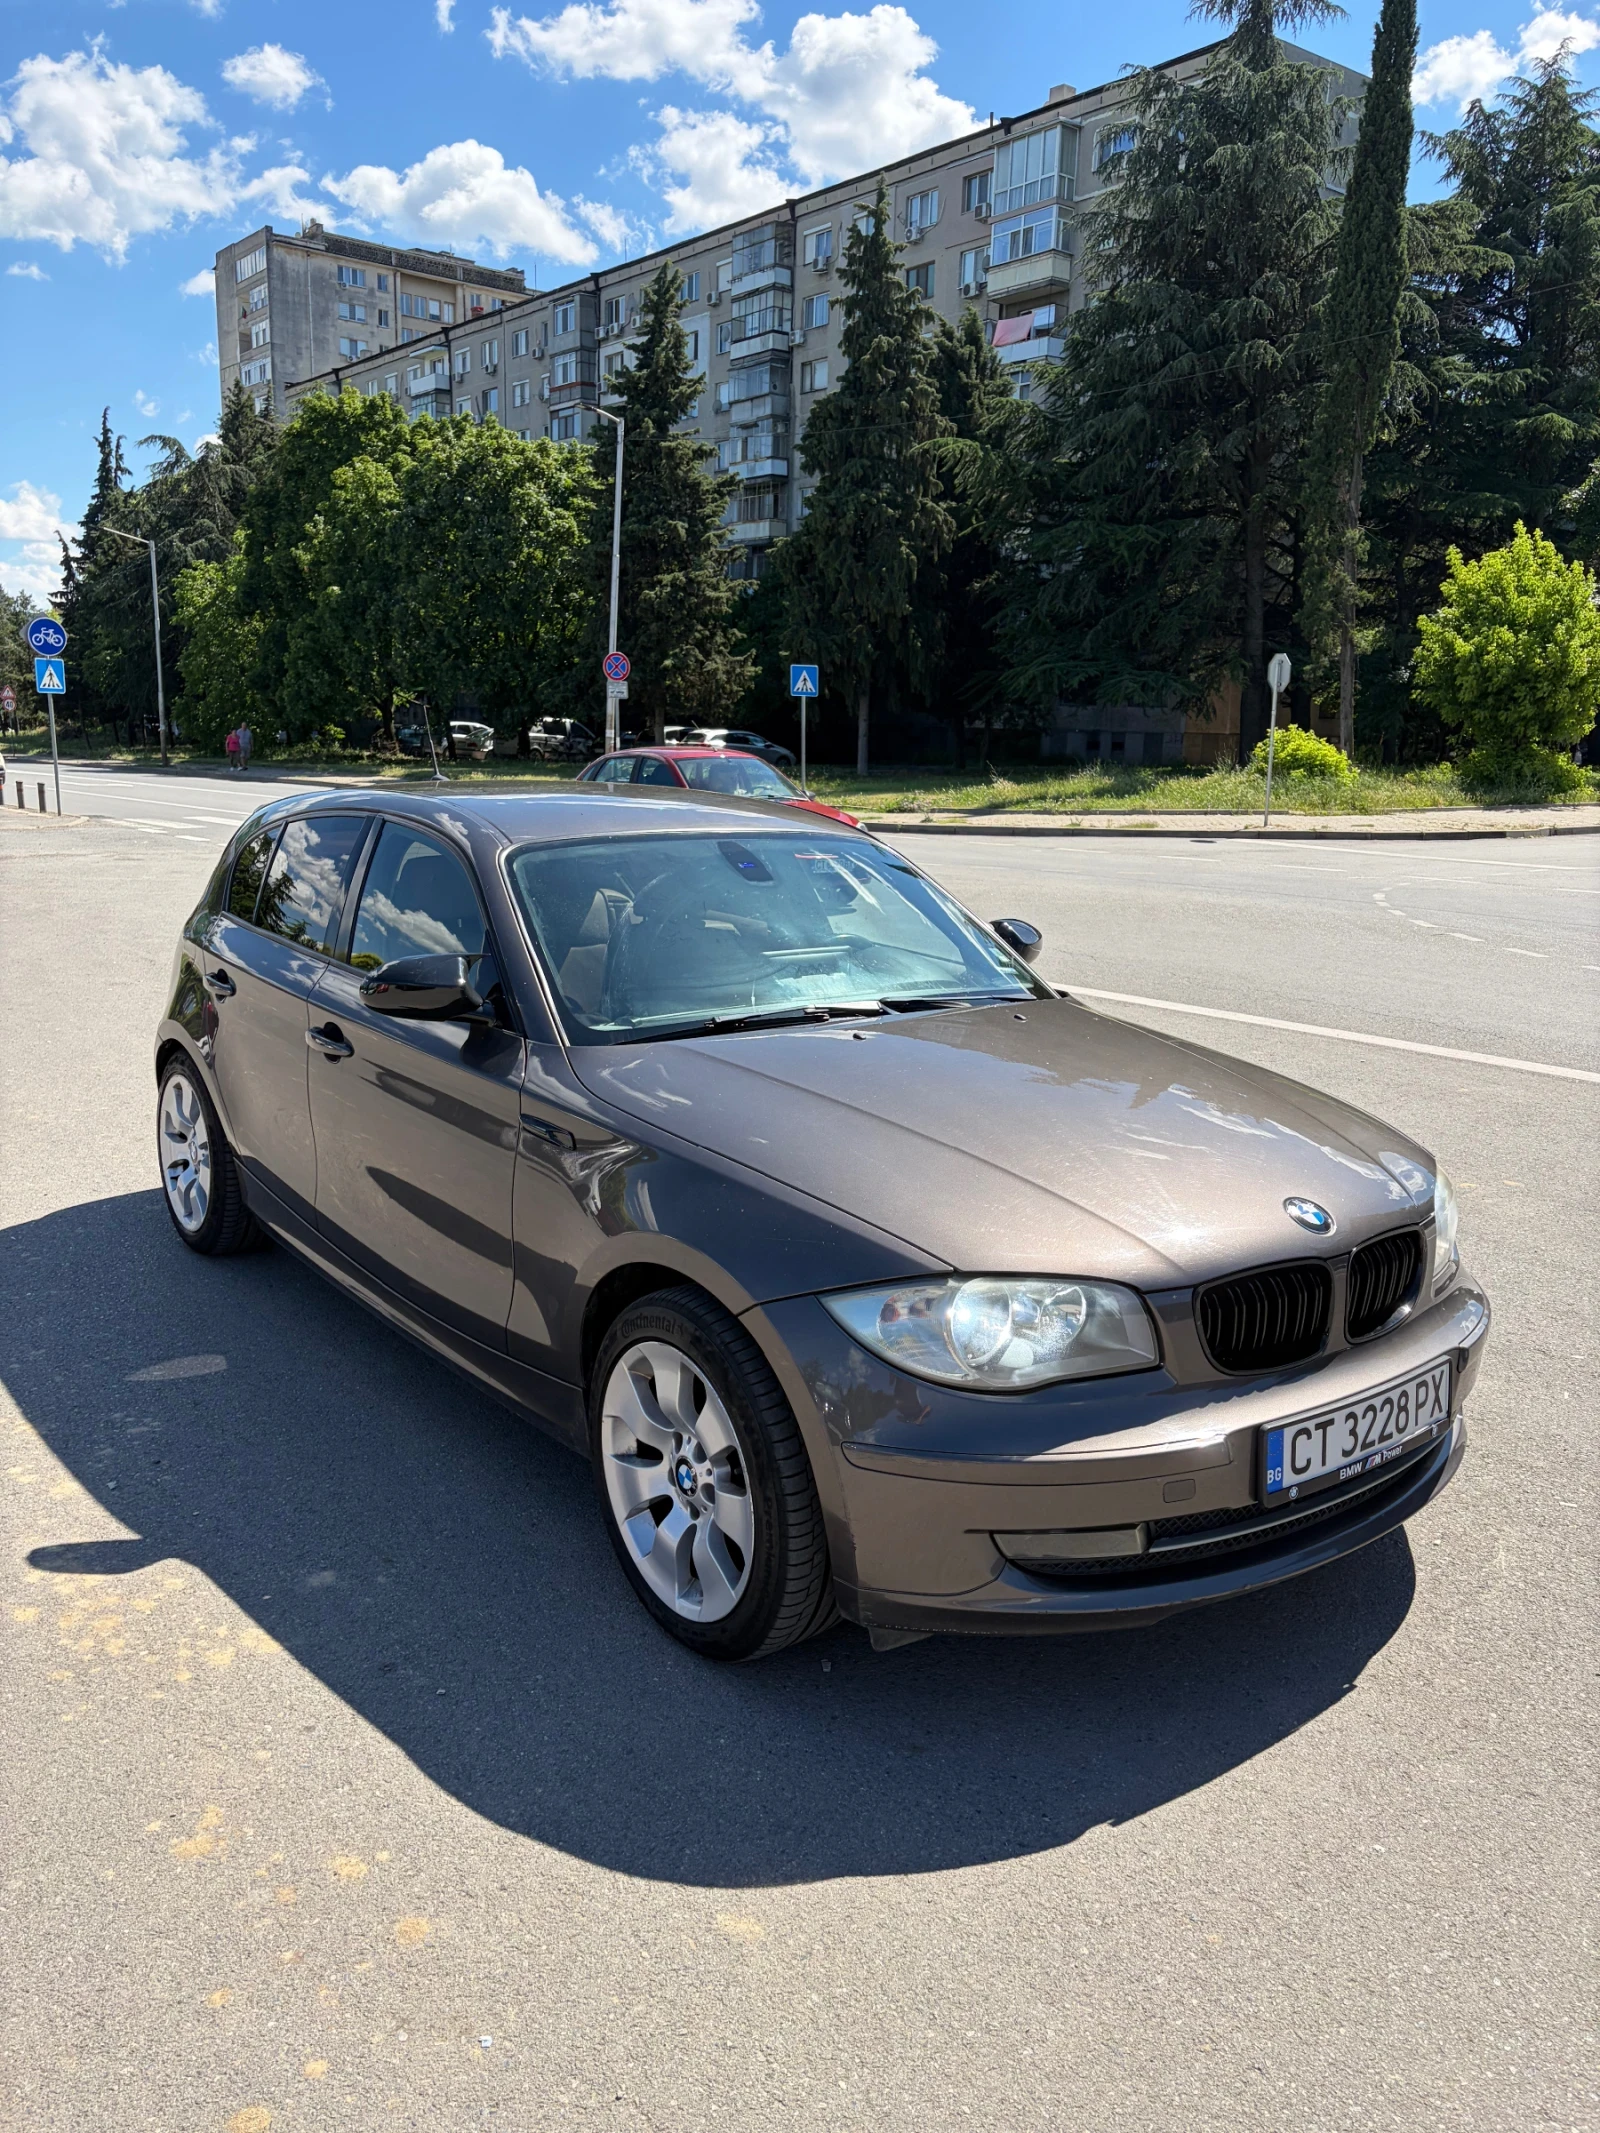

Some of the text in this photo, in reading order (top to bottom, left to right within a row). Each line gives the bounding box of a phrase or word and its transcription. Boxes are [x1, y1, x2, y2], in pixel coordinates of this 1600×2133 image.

[1341, 1389, 1410, 1458] 3228
[1267, 1468, 1282, 1484] BG
[1340, 1462, 1363, 1480] BMW
[1383, 1446, 1403, 1461] Power
